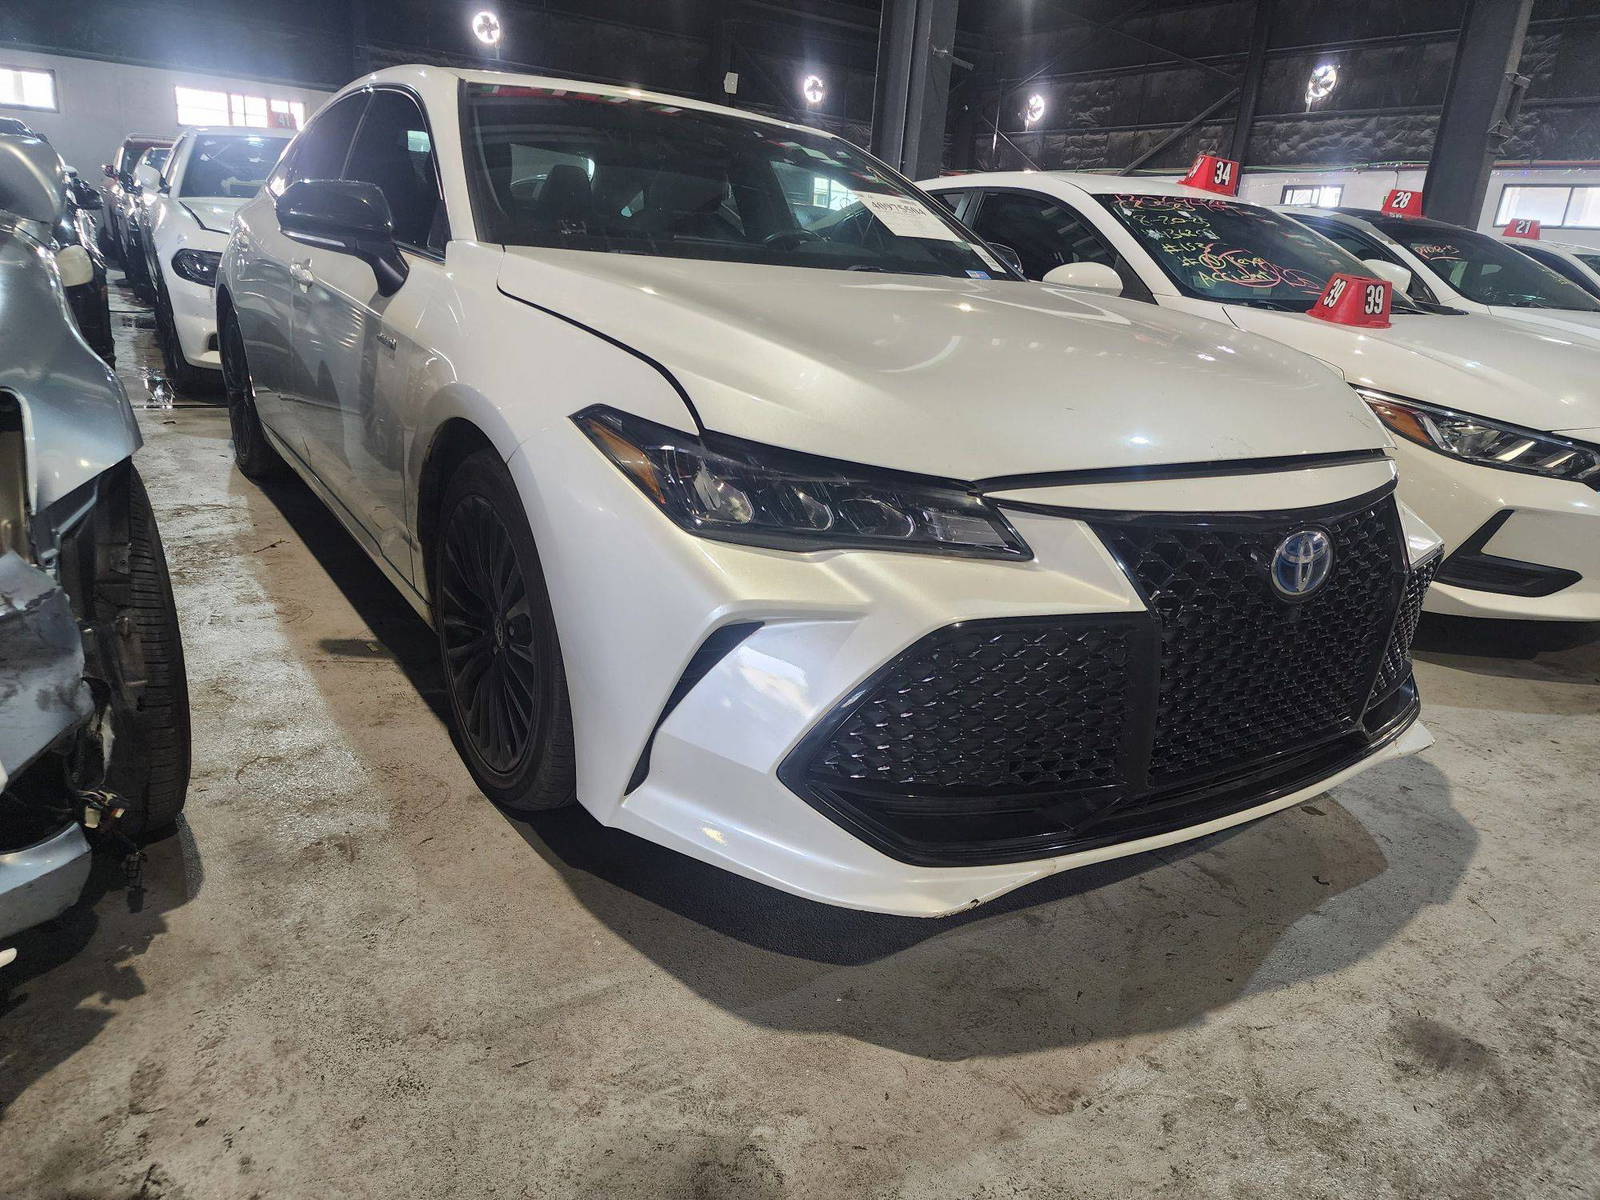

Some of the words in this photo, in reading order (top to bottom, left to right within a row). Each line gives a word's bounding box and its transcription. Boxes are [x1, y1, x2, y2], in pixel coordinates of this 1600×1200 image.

[1214, 161, 1232, 186] 34
[1391, 191, 1412, 209] 28
[1515, 219, 1532, 234] 21
[1323, 278, 1347, 308] 39
[1365, 284, 1385, 314] 39
